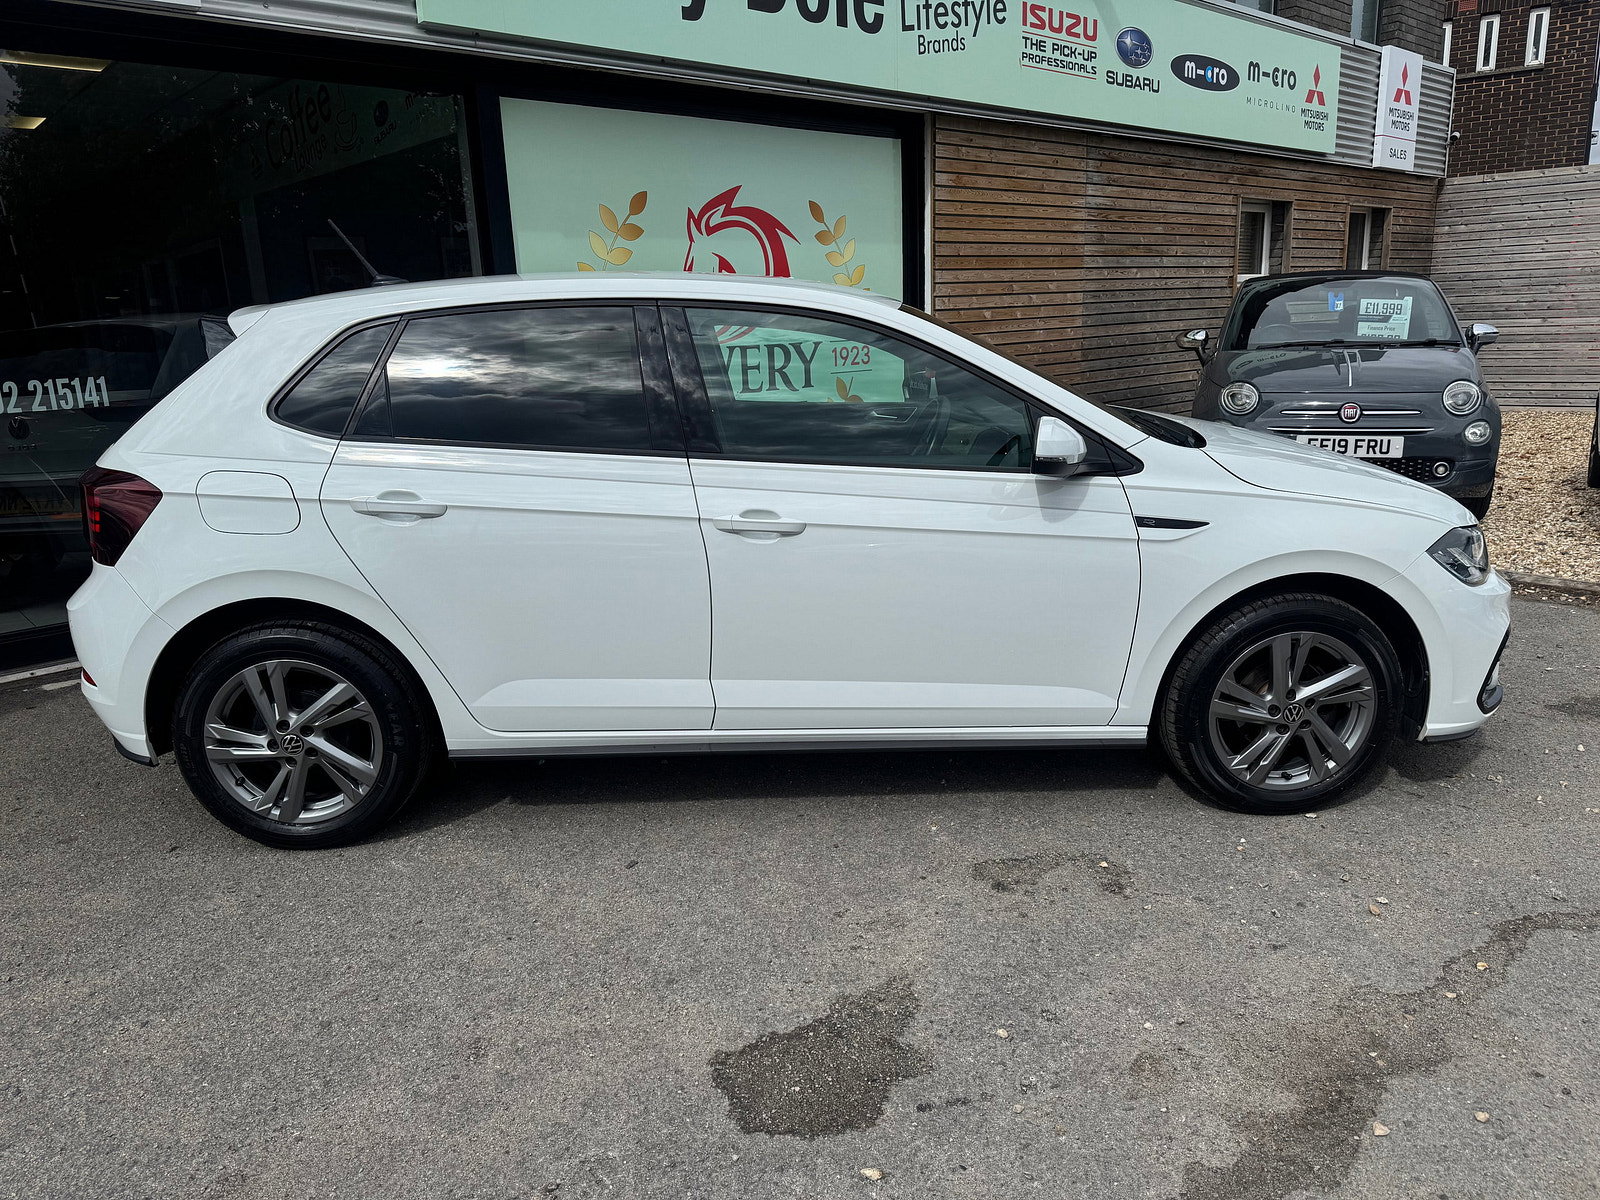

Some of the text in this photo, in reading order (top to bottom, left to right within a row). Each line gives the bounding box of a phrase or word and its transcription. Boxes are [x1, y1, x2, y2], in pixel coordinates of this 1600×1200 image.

[901, 0, 1007, 37] Lifestyle
[1022, 1, 1098, 42] ISUZU
[917, 30, 966, 55] Brands
[1022, 36, 1097, 62] THE PICK-UP
[1022, 52, 1097, 75] PROFESSIONALS
[1106, 70, 1160, 93] SUBARU
[1246, 96, 1296, 113] MICROLINO
[1389, 107, 1414, 121] MITSUBISHI
[1301, 108, 1329, 121] MITSUBISHI
[265, 84, 331, 169] Coffee
[1304, 120, 1325, 132] MOTORS
[1391, 119, 1410, 132] MOTORS
[1389, 147, 1407, 160] SALES
[1384, 325, 1396, 333] Price
[831, 345, 870, 367] 1923
[0, 376, 110, 414] 2 215141
[1344, 409, 1357, 418] FIAT
[1354, 439, 1391, 454] FRU
